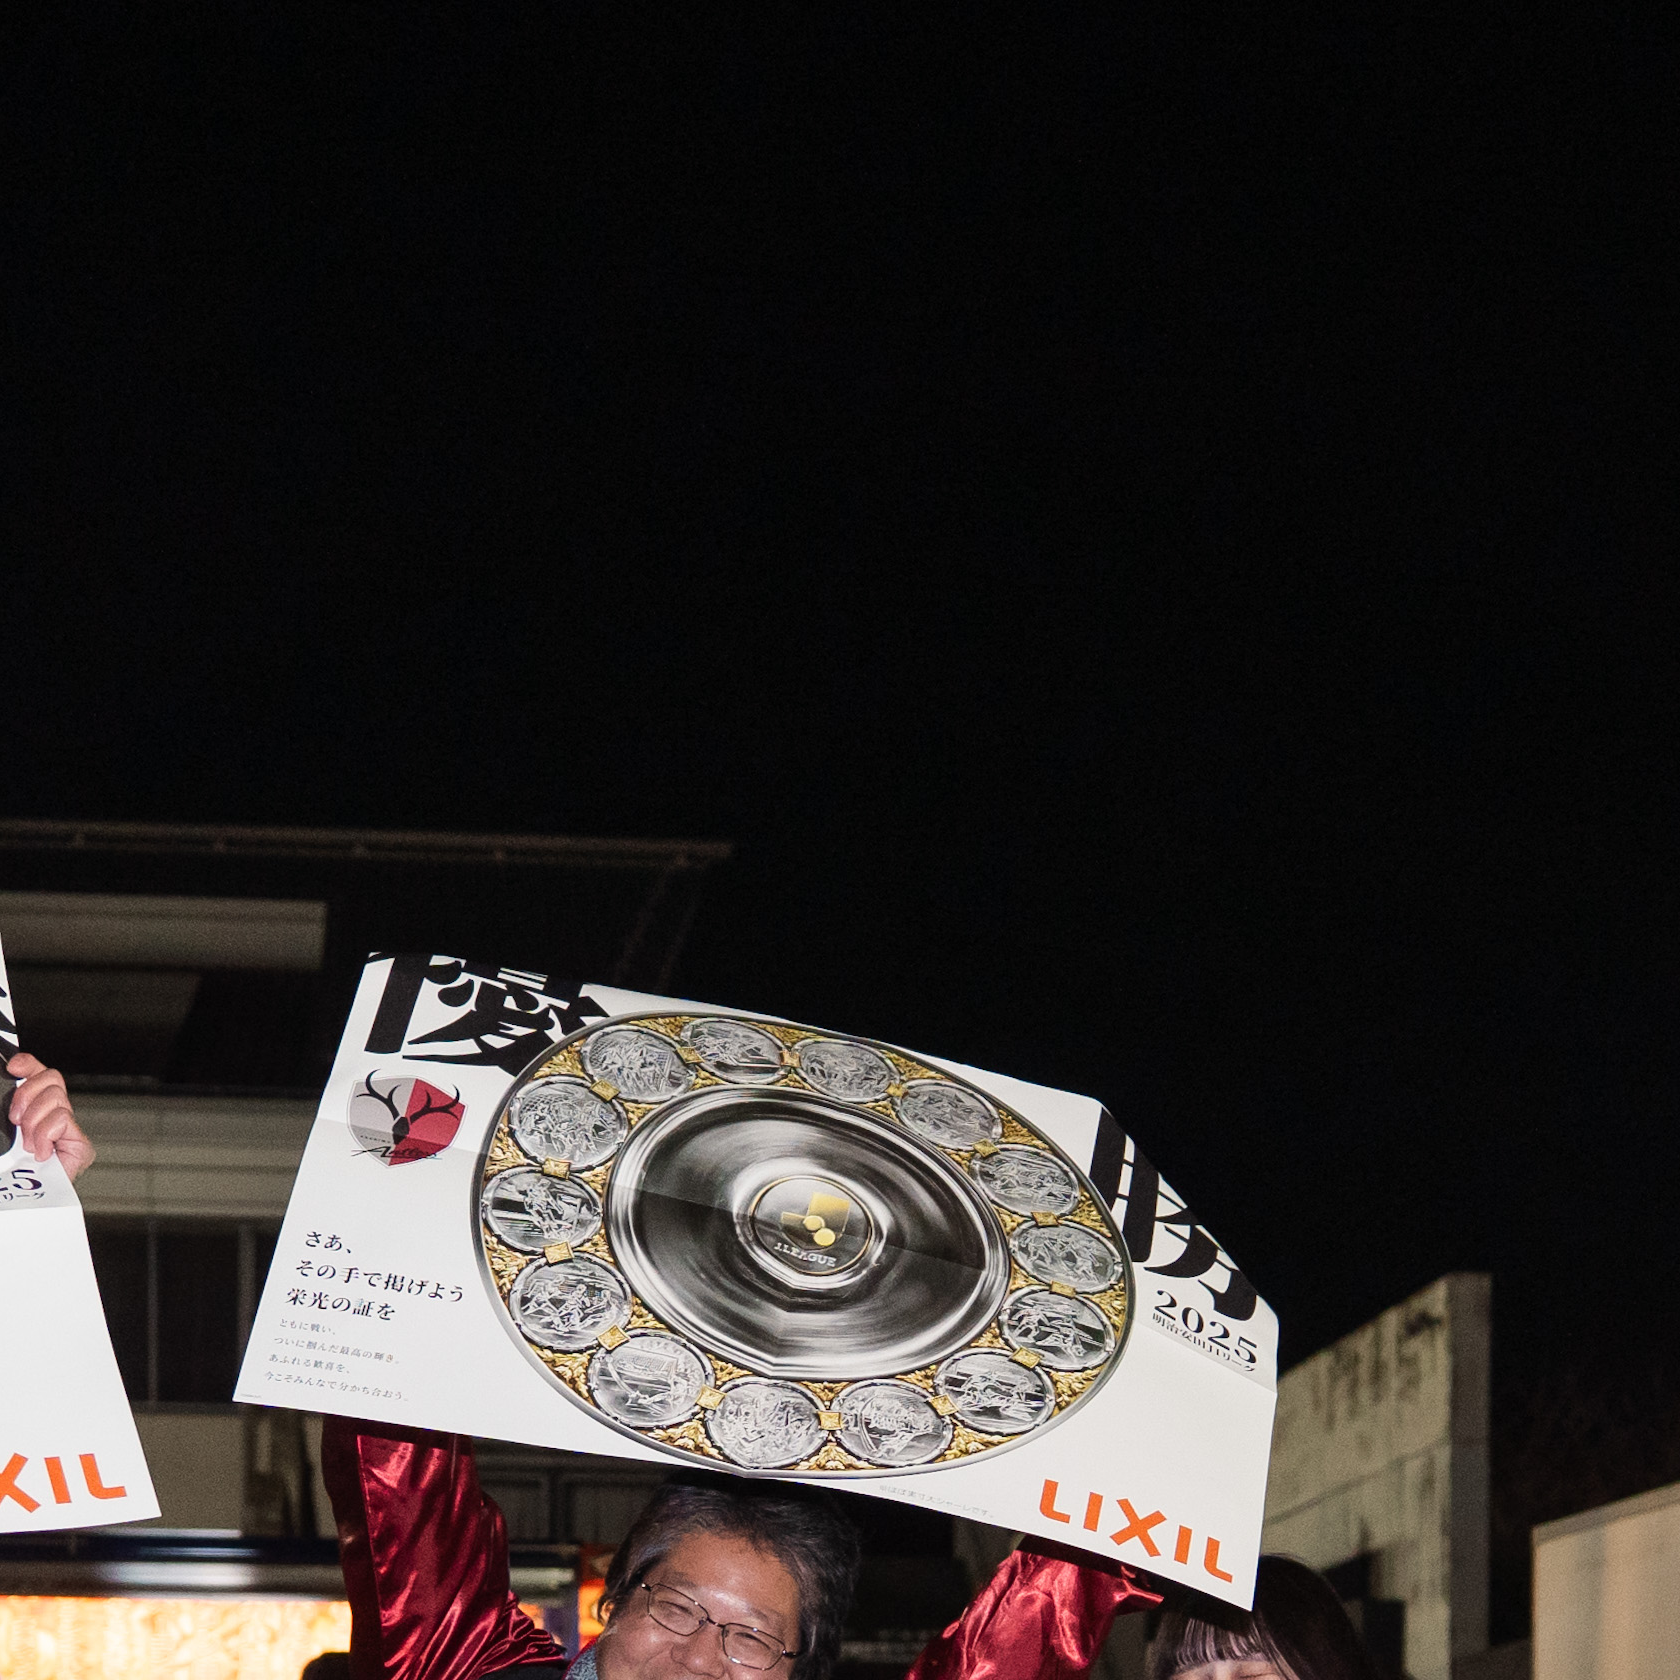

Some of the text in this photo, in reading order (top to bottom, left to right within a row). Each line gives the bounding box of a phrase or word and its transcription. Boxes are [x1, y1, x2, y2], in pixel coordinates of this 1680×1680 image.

[304, 1230, 353, 1255] さあ、
[295, 1259, 465, 1303] その手で掲げよう
[284, 1286, 396, 1322] 栄光の証を
[1153, 1289, 1259, 1365] 2025
[1038, 1478, 1234, 1584] LIXIL
